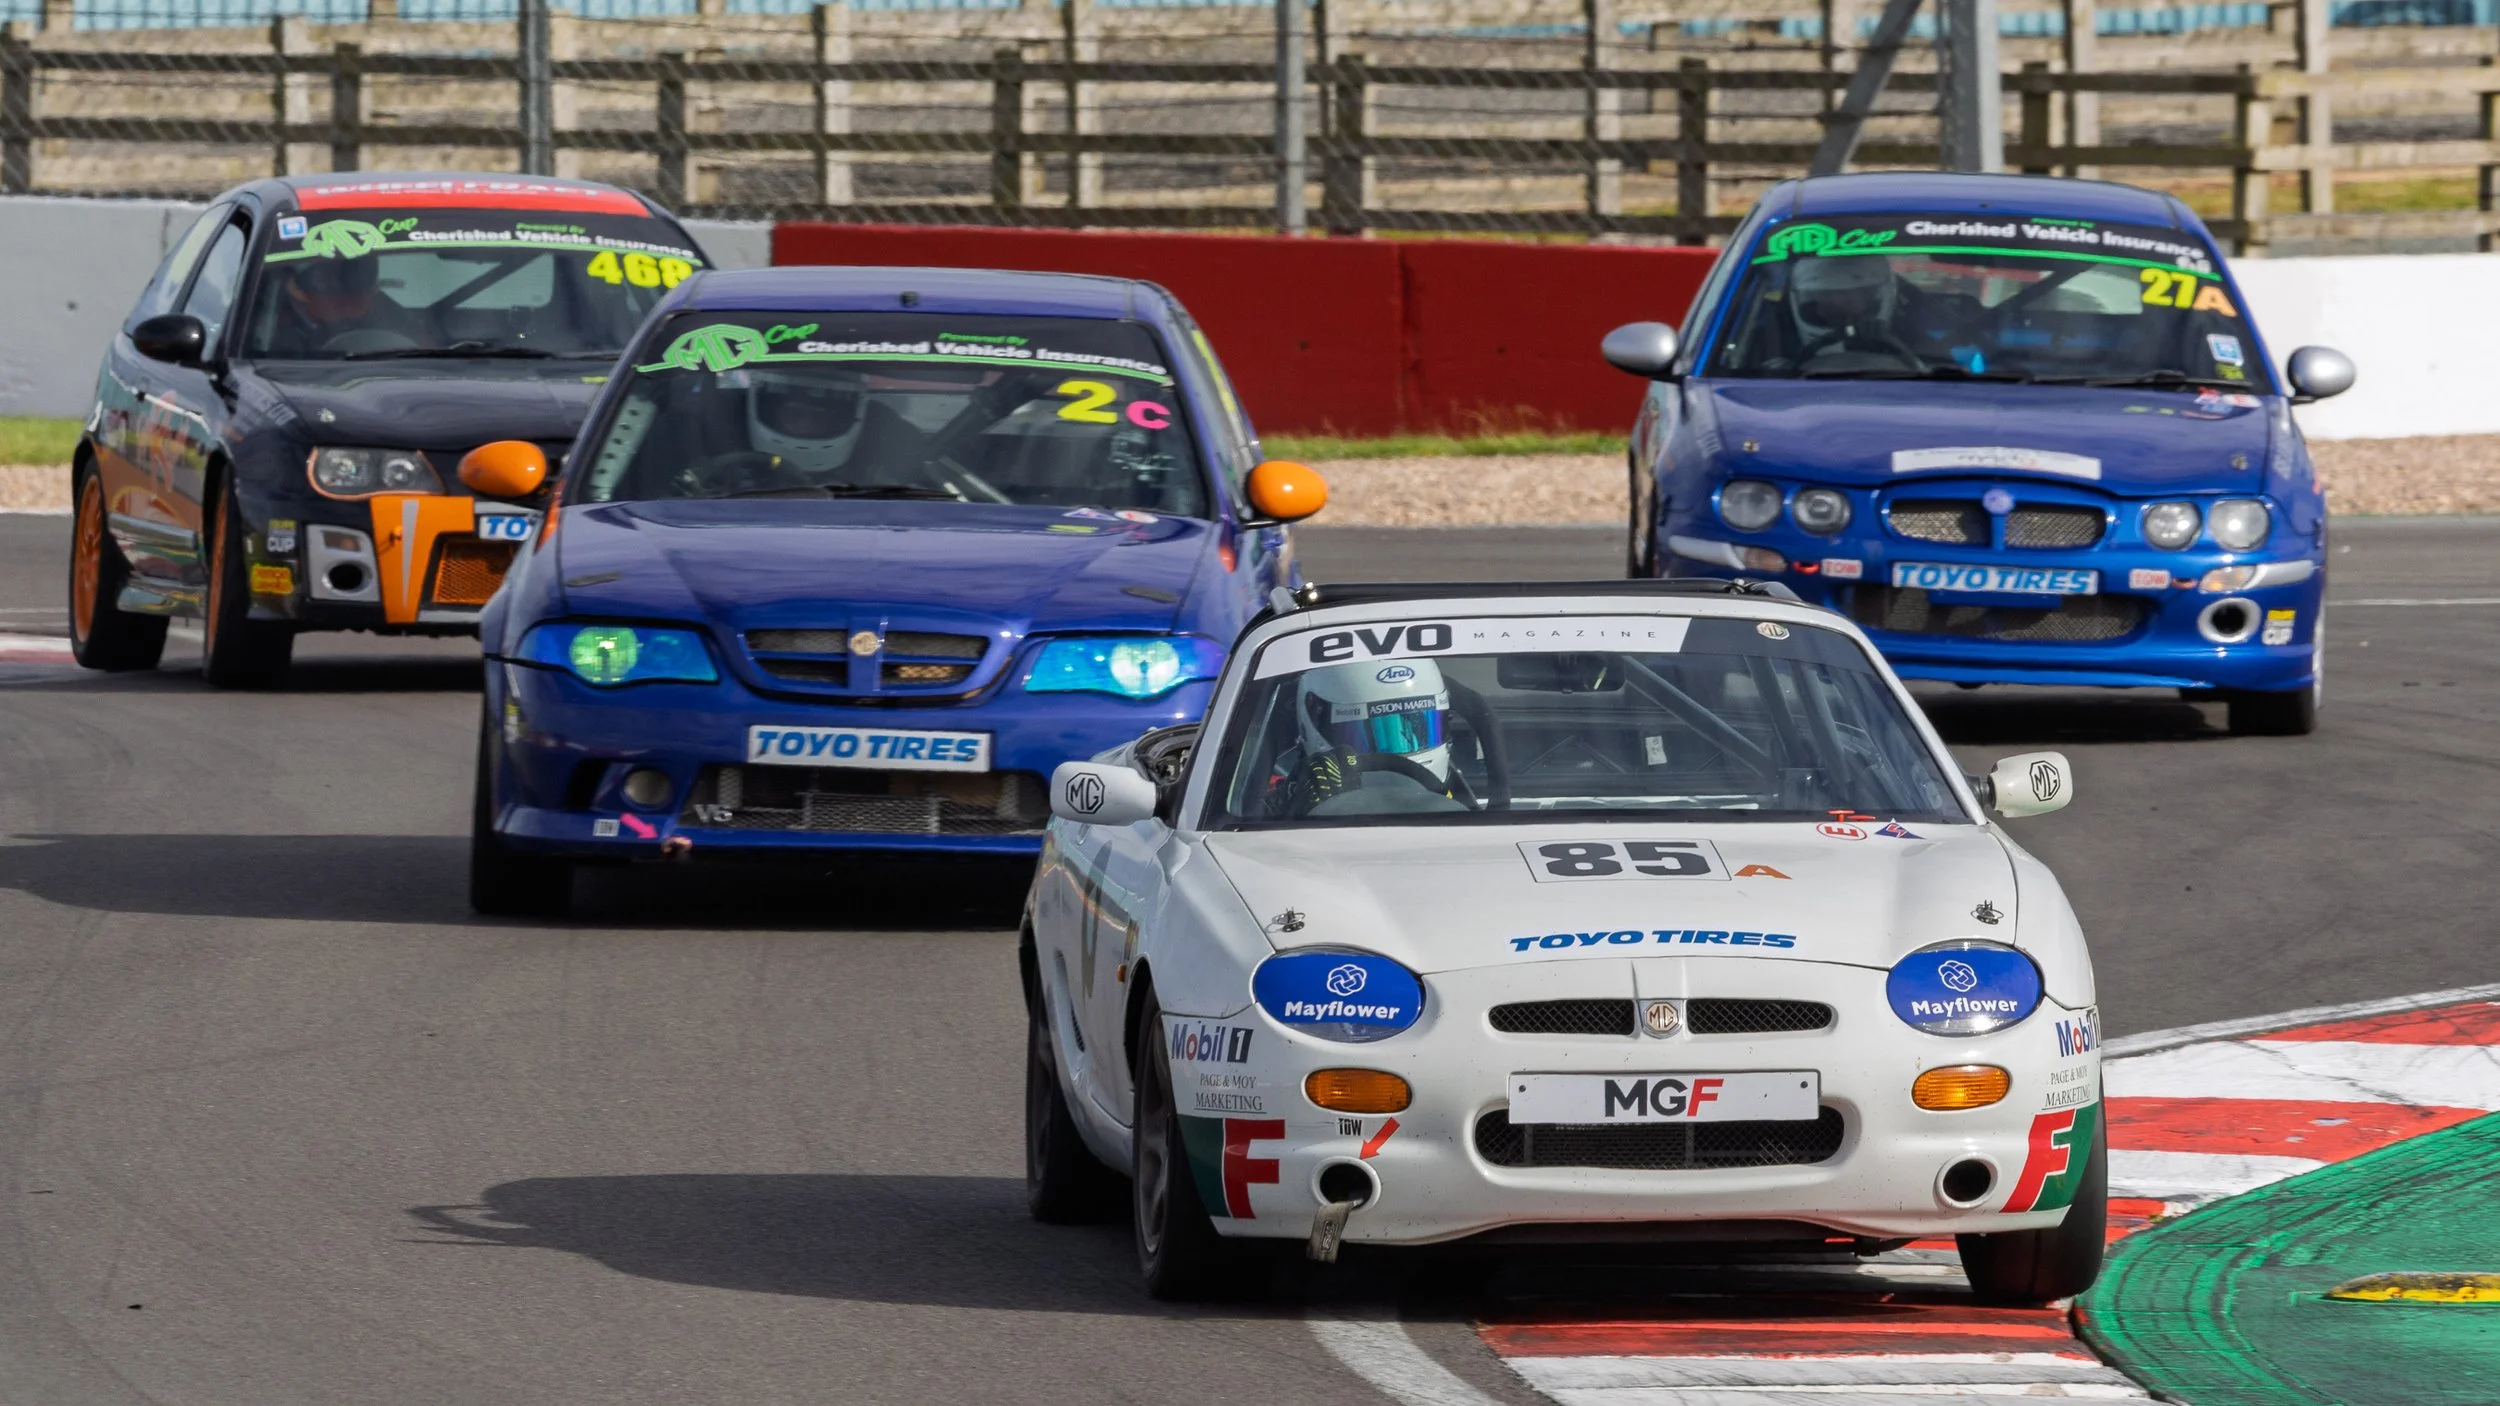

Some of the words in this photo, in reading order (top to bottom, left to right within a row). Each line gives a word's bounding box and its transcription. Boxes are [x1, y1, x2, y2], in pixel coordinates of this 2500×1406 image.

[379, 217, 419, 234] Cup
[1838, 229, 1898, 248] Cup
[1905, 221, 2016, 238] Cherished
[2021, 223, 2099, 243] Vehicle
[2102, 231, 2205, 259] Insurance
[409, 229, 512, 242] Cherished
[515, 230, 592, 244] Vehicle
[594, 235, 695, 258] Insurance
[587, 251, 693, 290] 468
[2140, 268, 2197, 309] 27
[2193, 285, 2237, 317] A
[764, 323, 819, 344] Cup
[798, 341, 931, 354] Cherished
[933, 341, 1032, 359] Vehicle
[1036, 348, 1168, 376] Insurance
[1056, 380, 1118, 423] 2
[1125, 401, 1170, 429] C
[487, 515, 529, 537] TO
[1897, 564, 1995, 589] TOYO
[1998, 569, 2092, 593] TIRES
[1309, 623, 1452, 664] evo
[1473, 629, 1656, 640] MAGAZINE
[1384, 667, 1411, 680] Arai
[1369, 702, 1403, 715] ASTON
[1404, 699, 1436, 711] MARTIN
[756, 730, 859, 758] TOYO
[866, 735, 980, 762] TIRES
[1068, 775, 1102, 812] MG
[2032, 763, 2059, 800] MG
[1538, 842, 1711, 877] 85
[1734, 864, 1793, 880] A
[1510, 931, 1644, 952] TOYO
[1652, 930, 1797, 949] TIRES
[1284, 1001, 1400, 1020] Mayflower
[1647, 1003, 1676, 1030] MG
[1911, 997, 2018, 1017] Mayflower
[1172, 1023, 1226, 1062] Mobil
[2055, 1012, 2095, 1058] Mobil
[1200, 1073, 1222, 1087] PAGE
[1222, 1074, 1231, 1087] &
[1232, 1074, 1256, 1089] MOY
[2050, 1070, 2070, 1085] PAGE
[1195, 1092, 1263, 1111] MARKETING
[1605, 1078, 1724, 1117] MGF
[2045, 1083, 2091, 1107] MARKETING
[1338, 1118, 1362, 1136] TOW
[1223, 1118, 1285, 1219] F
[2000, 1108, 2075, 1213] F
